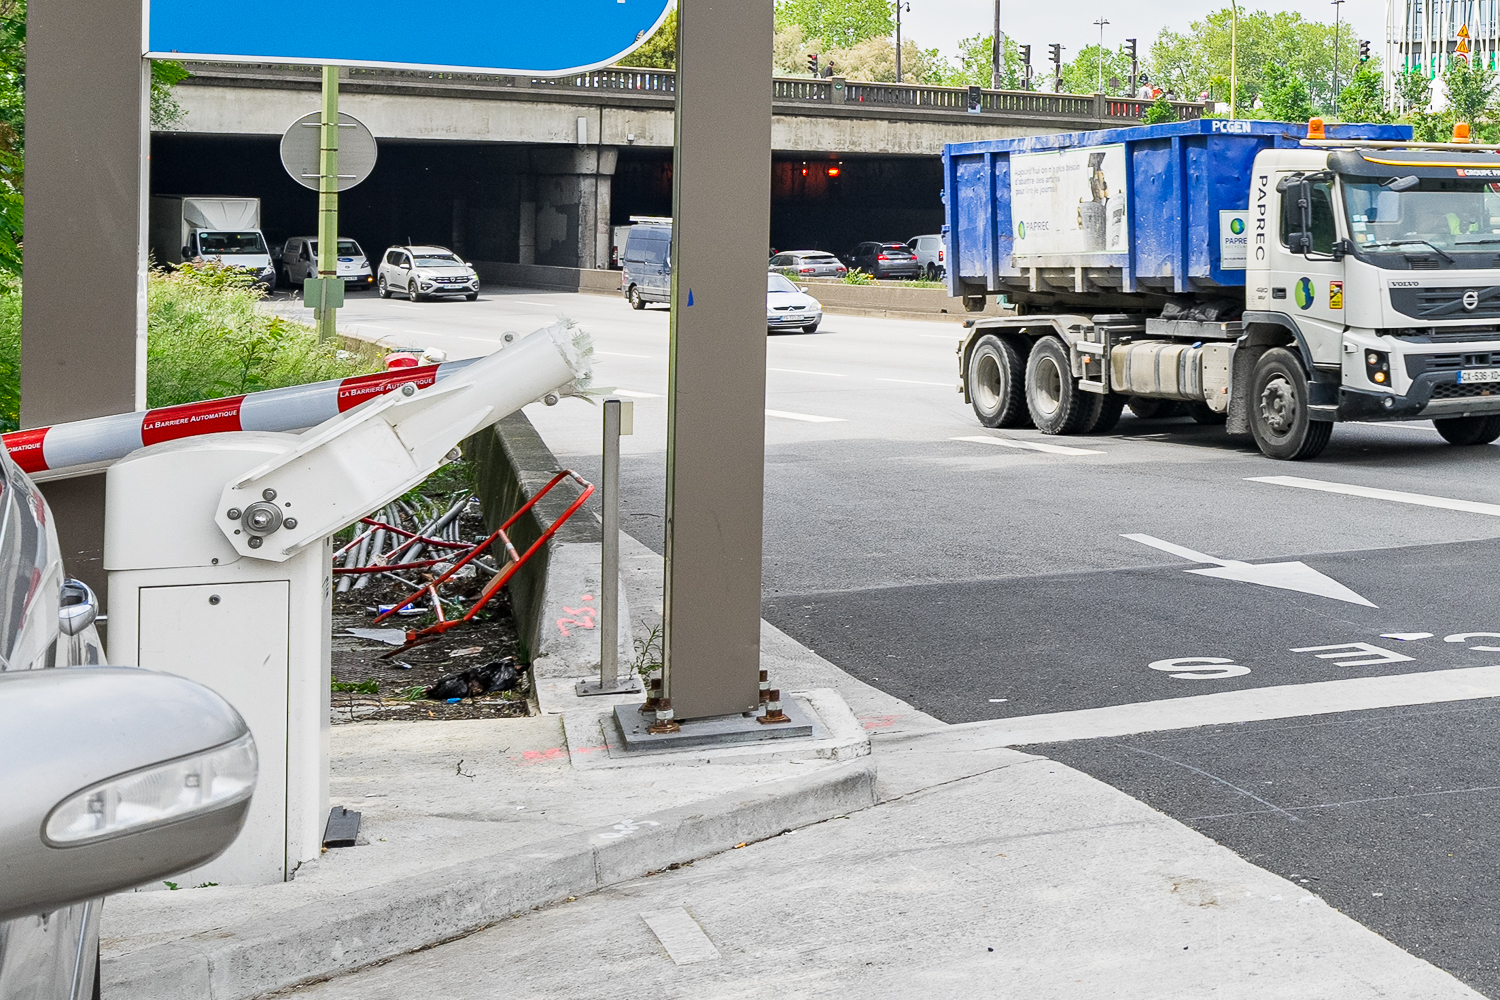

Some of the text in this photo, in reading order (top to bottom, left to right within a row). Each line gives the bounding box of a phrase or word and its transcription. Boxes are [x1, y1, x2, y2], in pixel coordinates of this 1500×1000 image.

[1255, 175, 1269, 261] PAPREC
[1026, 221, 1050, 231] PAPREC
[1225, 237, 1248, 245] PAPRE
[386, 378, 433, 390] AUTOTIQUE
[190, 409, 238, 423] AUTOMATIQUE
[7, 442, 42, 454] OMATIQUE
